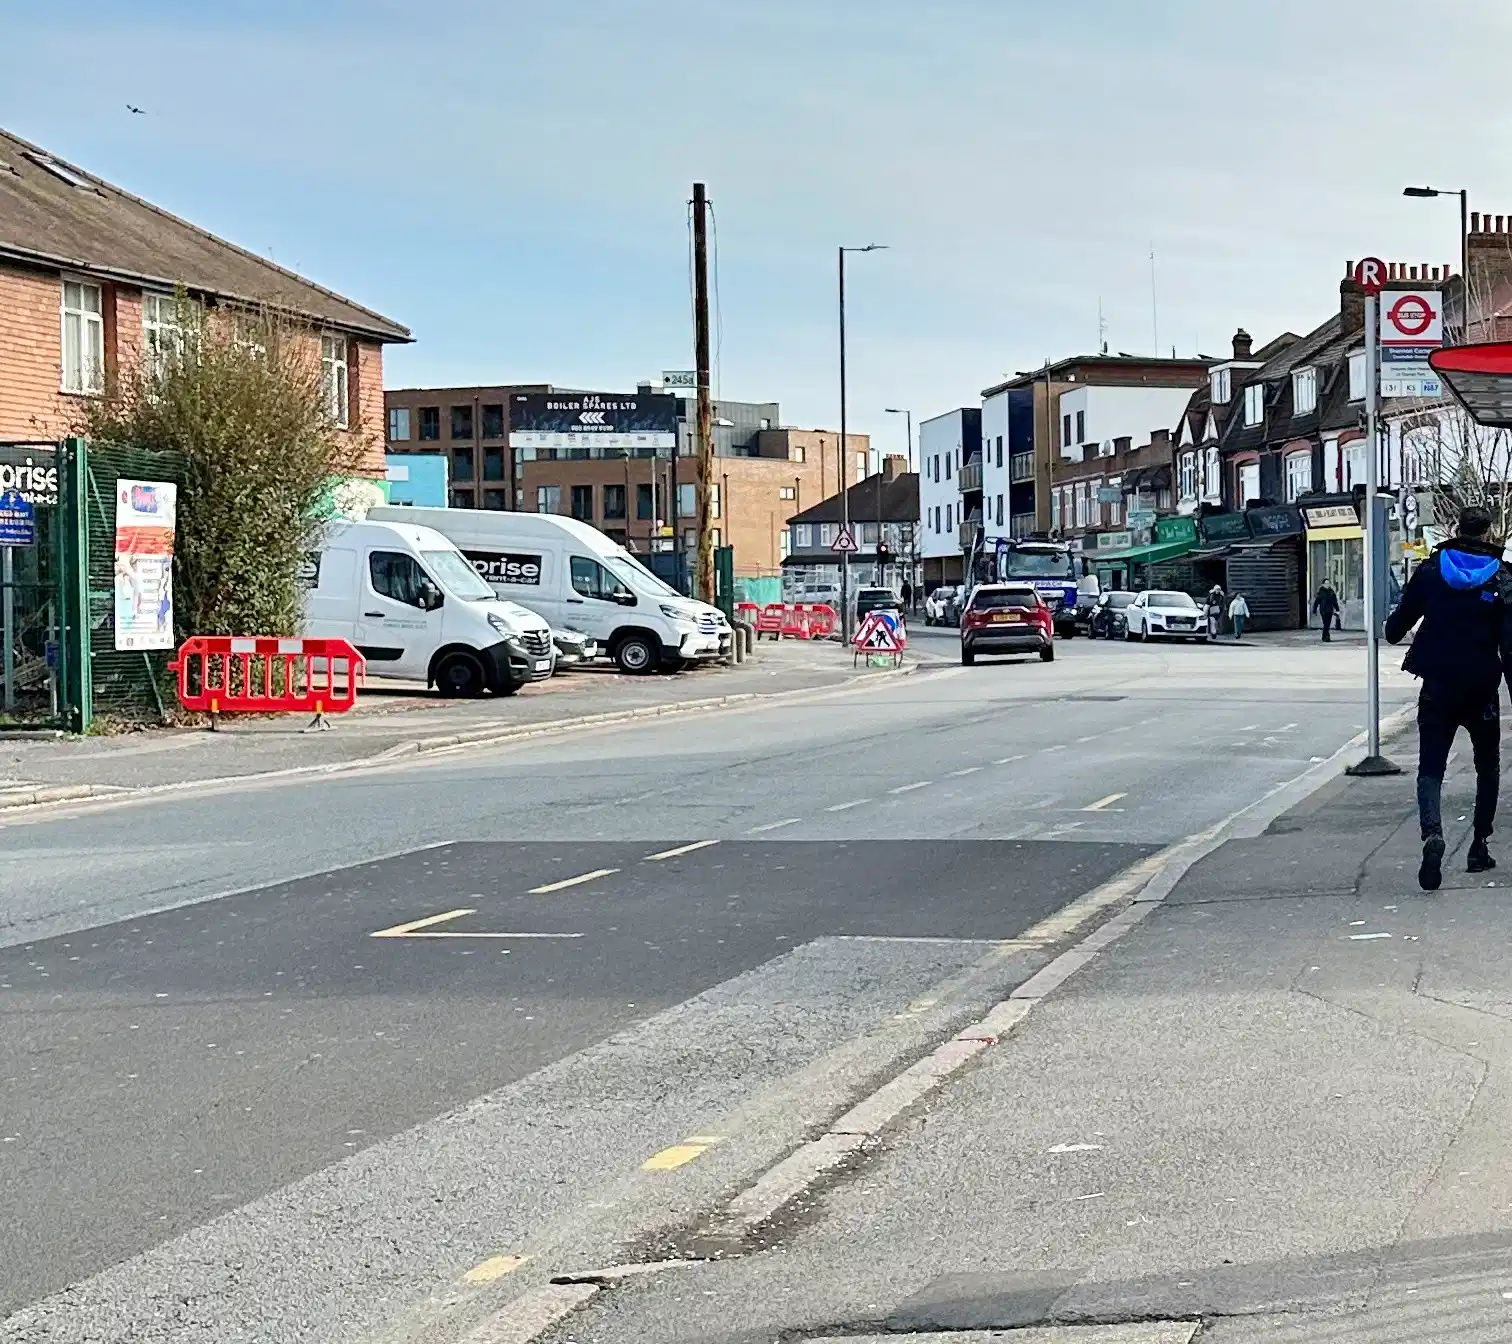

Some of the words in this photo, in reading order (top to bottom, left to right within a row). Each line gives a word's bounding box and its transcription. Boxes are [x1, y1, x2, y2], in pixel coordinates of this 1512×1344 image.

[1362, 260, 1380, 285] R
[547, 402, 580, 410] BOILER
[582, 402, 618, 410] SPARES
[620, 402, 637, 410] LTD
[0, 457, 58, 494] prise
[471, 557, 539, 577] prise
[484, 574, 538, 584] rent-a-car
